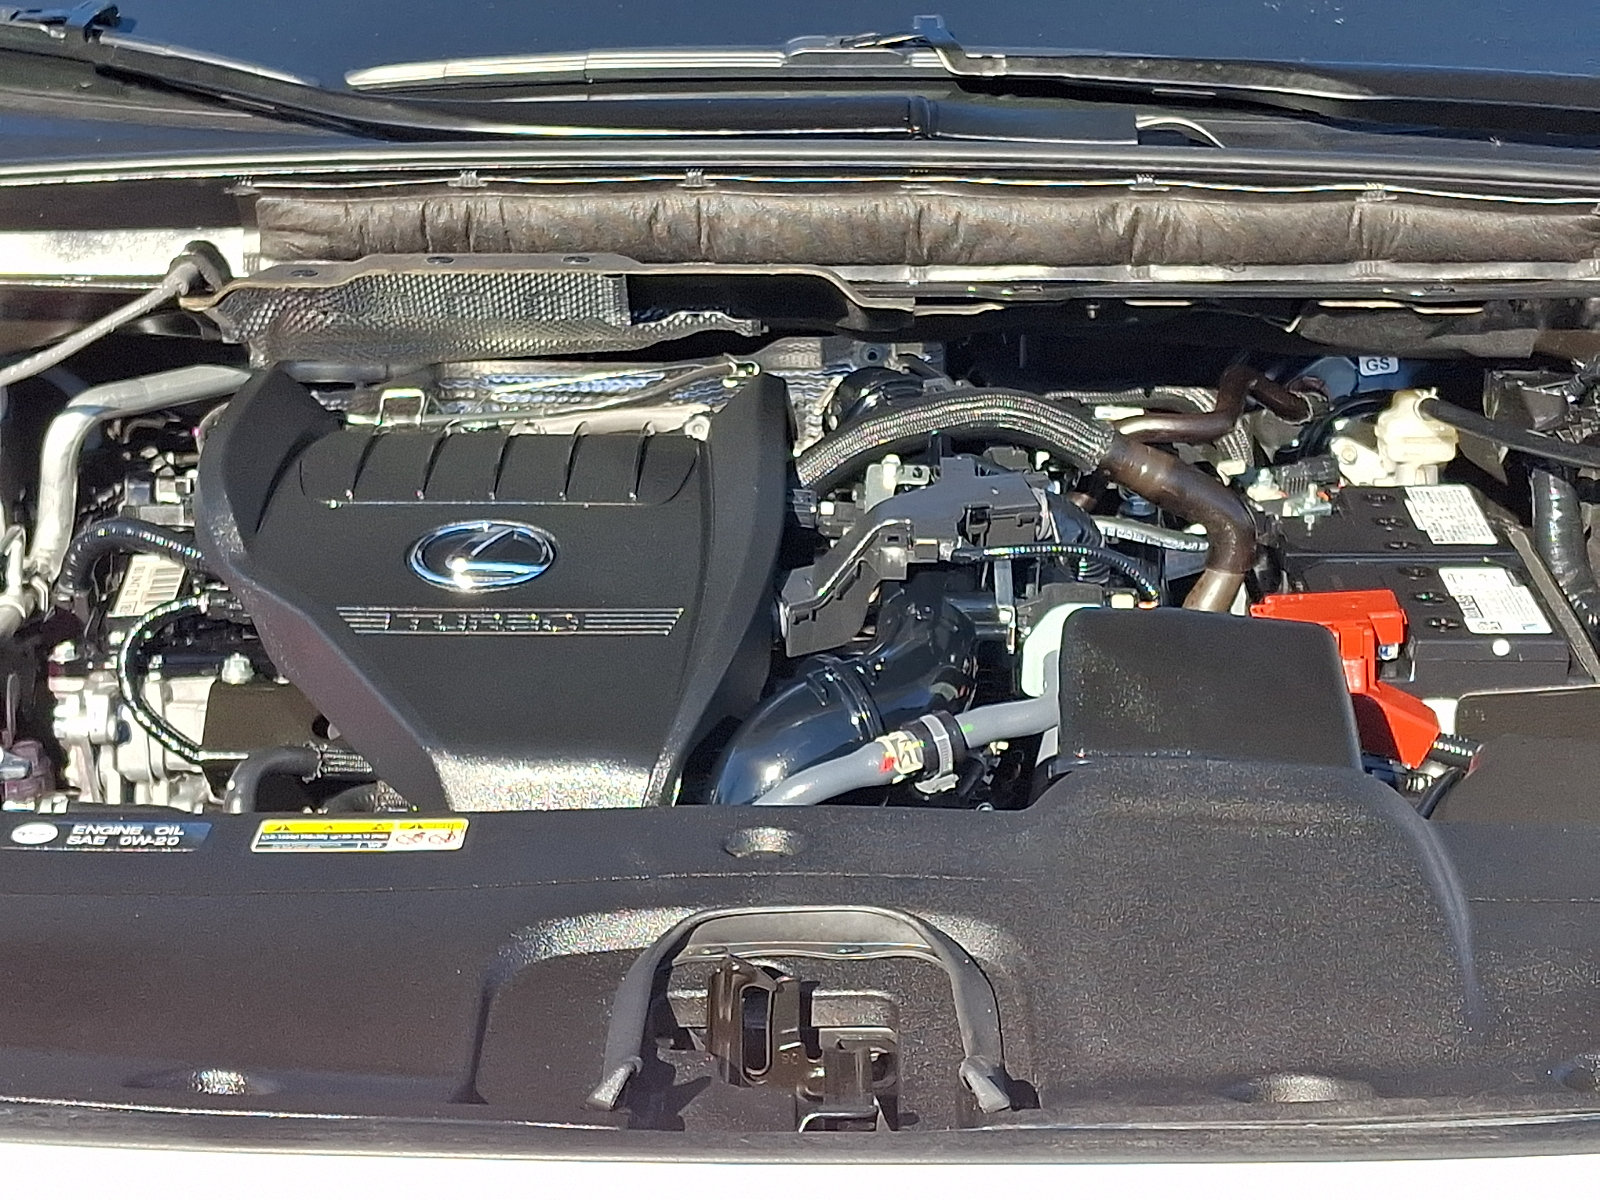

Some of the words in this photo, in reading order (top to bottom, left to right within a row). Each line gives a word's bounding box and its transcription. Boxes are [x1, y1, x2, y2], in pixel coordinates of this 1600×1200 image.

[1366, 357, 1390, 371] GS
[396, 613, 578, 631] TURBO
[71, 823, 144, 836] ENGINE
[154, 825, 185, 836] OIL
[66, 835, 109, 846] SAE
[119, 835, 180, 847] 0W-20
